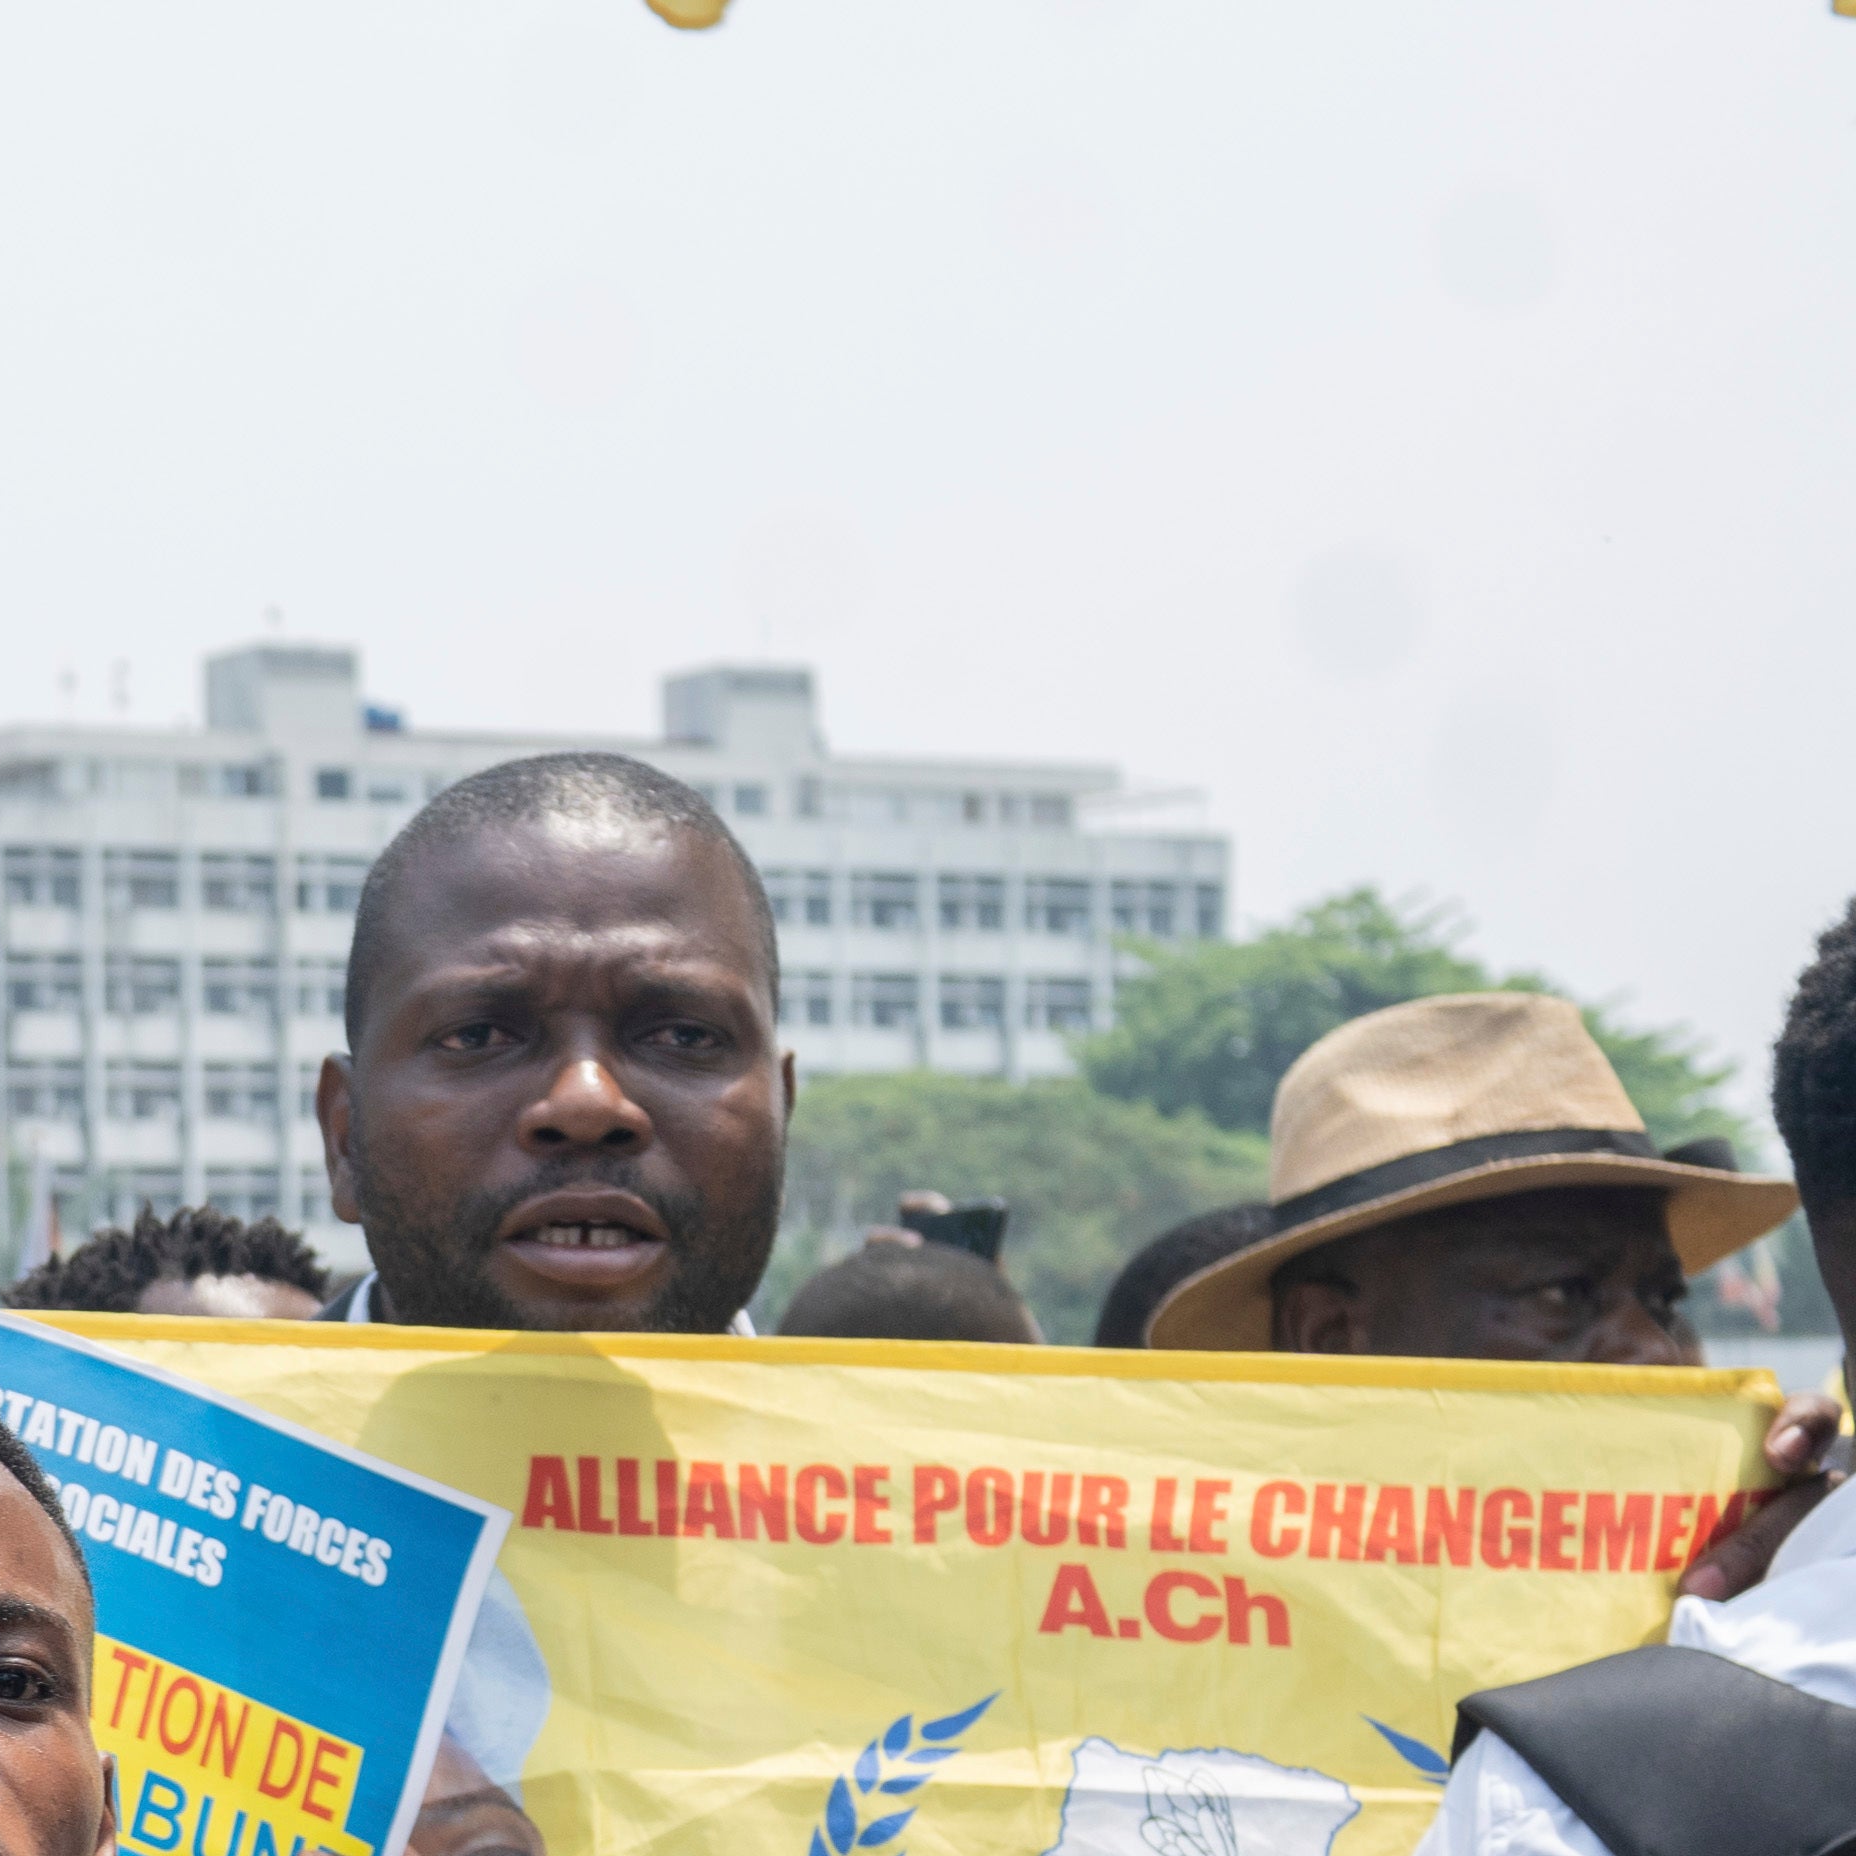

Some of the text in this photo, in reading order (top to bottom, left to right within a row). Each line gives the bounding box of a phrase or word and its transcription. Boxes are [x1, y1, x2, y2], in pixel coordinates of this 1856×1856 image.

[158, 1447, 242, 1521] DES
[240, 1482, 394, 1588] FORCES
[520, 1454, 1782, 1574] ALLIANCE POUR LE CHANGEMEN
[1037, 1562, 1293, 1649] A.Ch
[258, 1718, 351, 1823] DE
